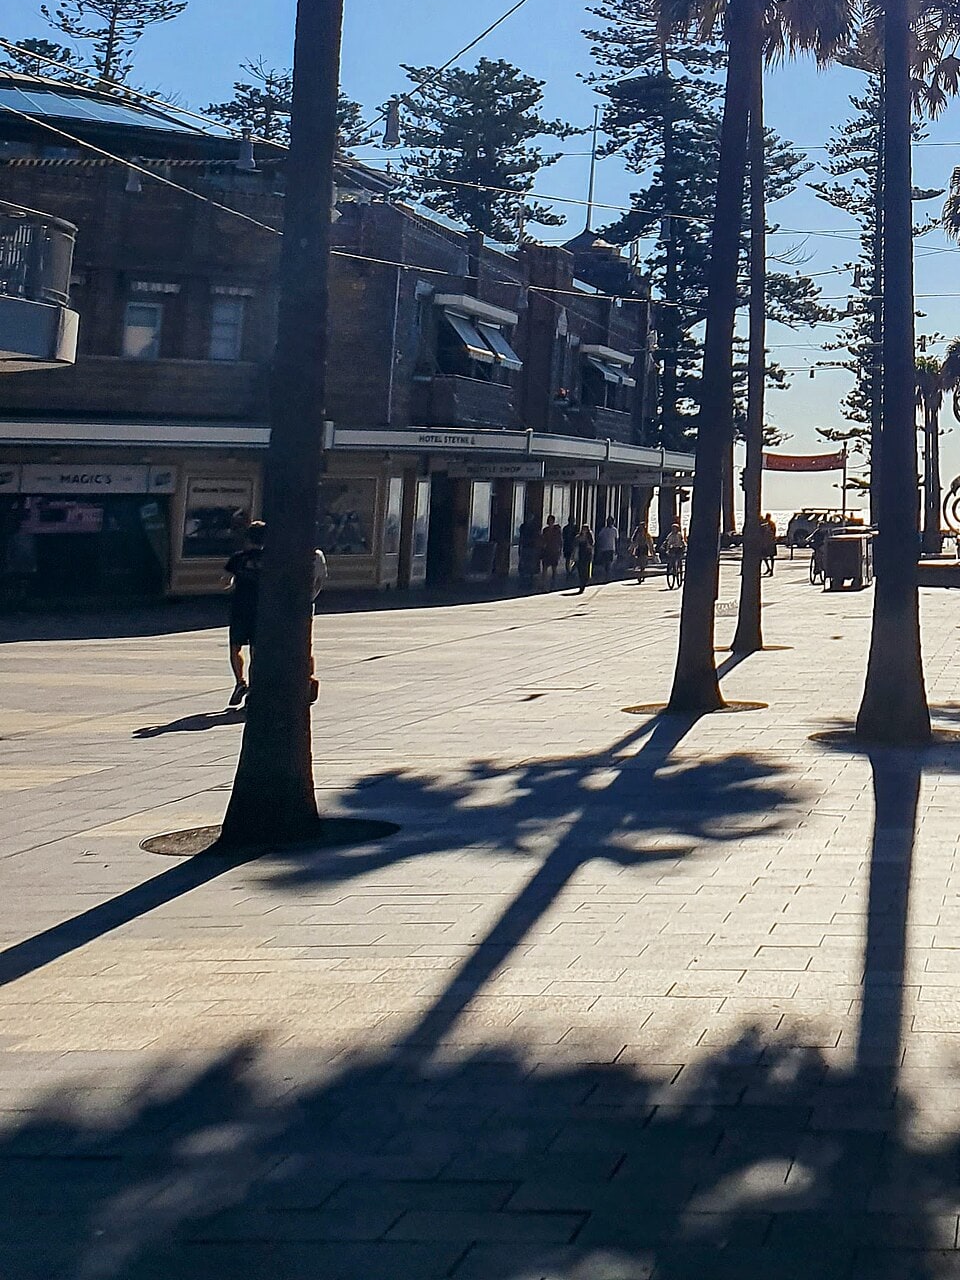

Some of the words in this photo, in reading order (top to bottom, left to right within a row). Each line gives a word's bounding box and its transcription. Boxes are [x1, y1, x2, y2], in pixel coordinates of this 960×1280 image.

[418, 434, 442, 443] HOTEL
[444, 436, 469, 444] STEYNE
[60, 474, 112, 484] MAGIC'S
